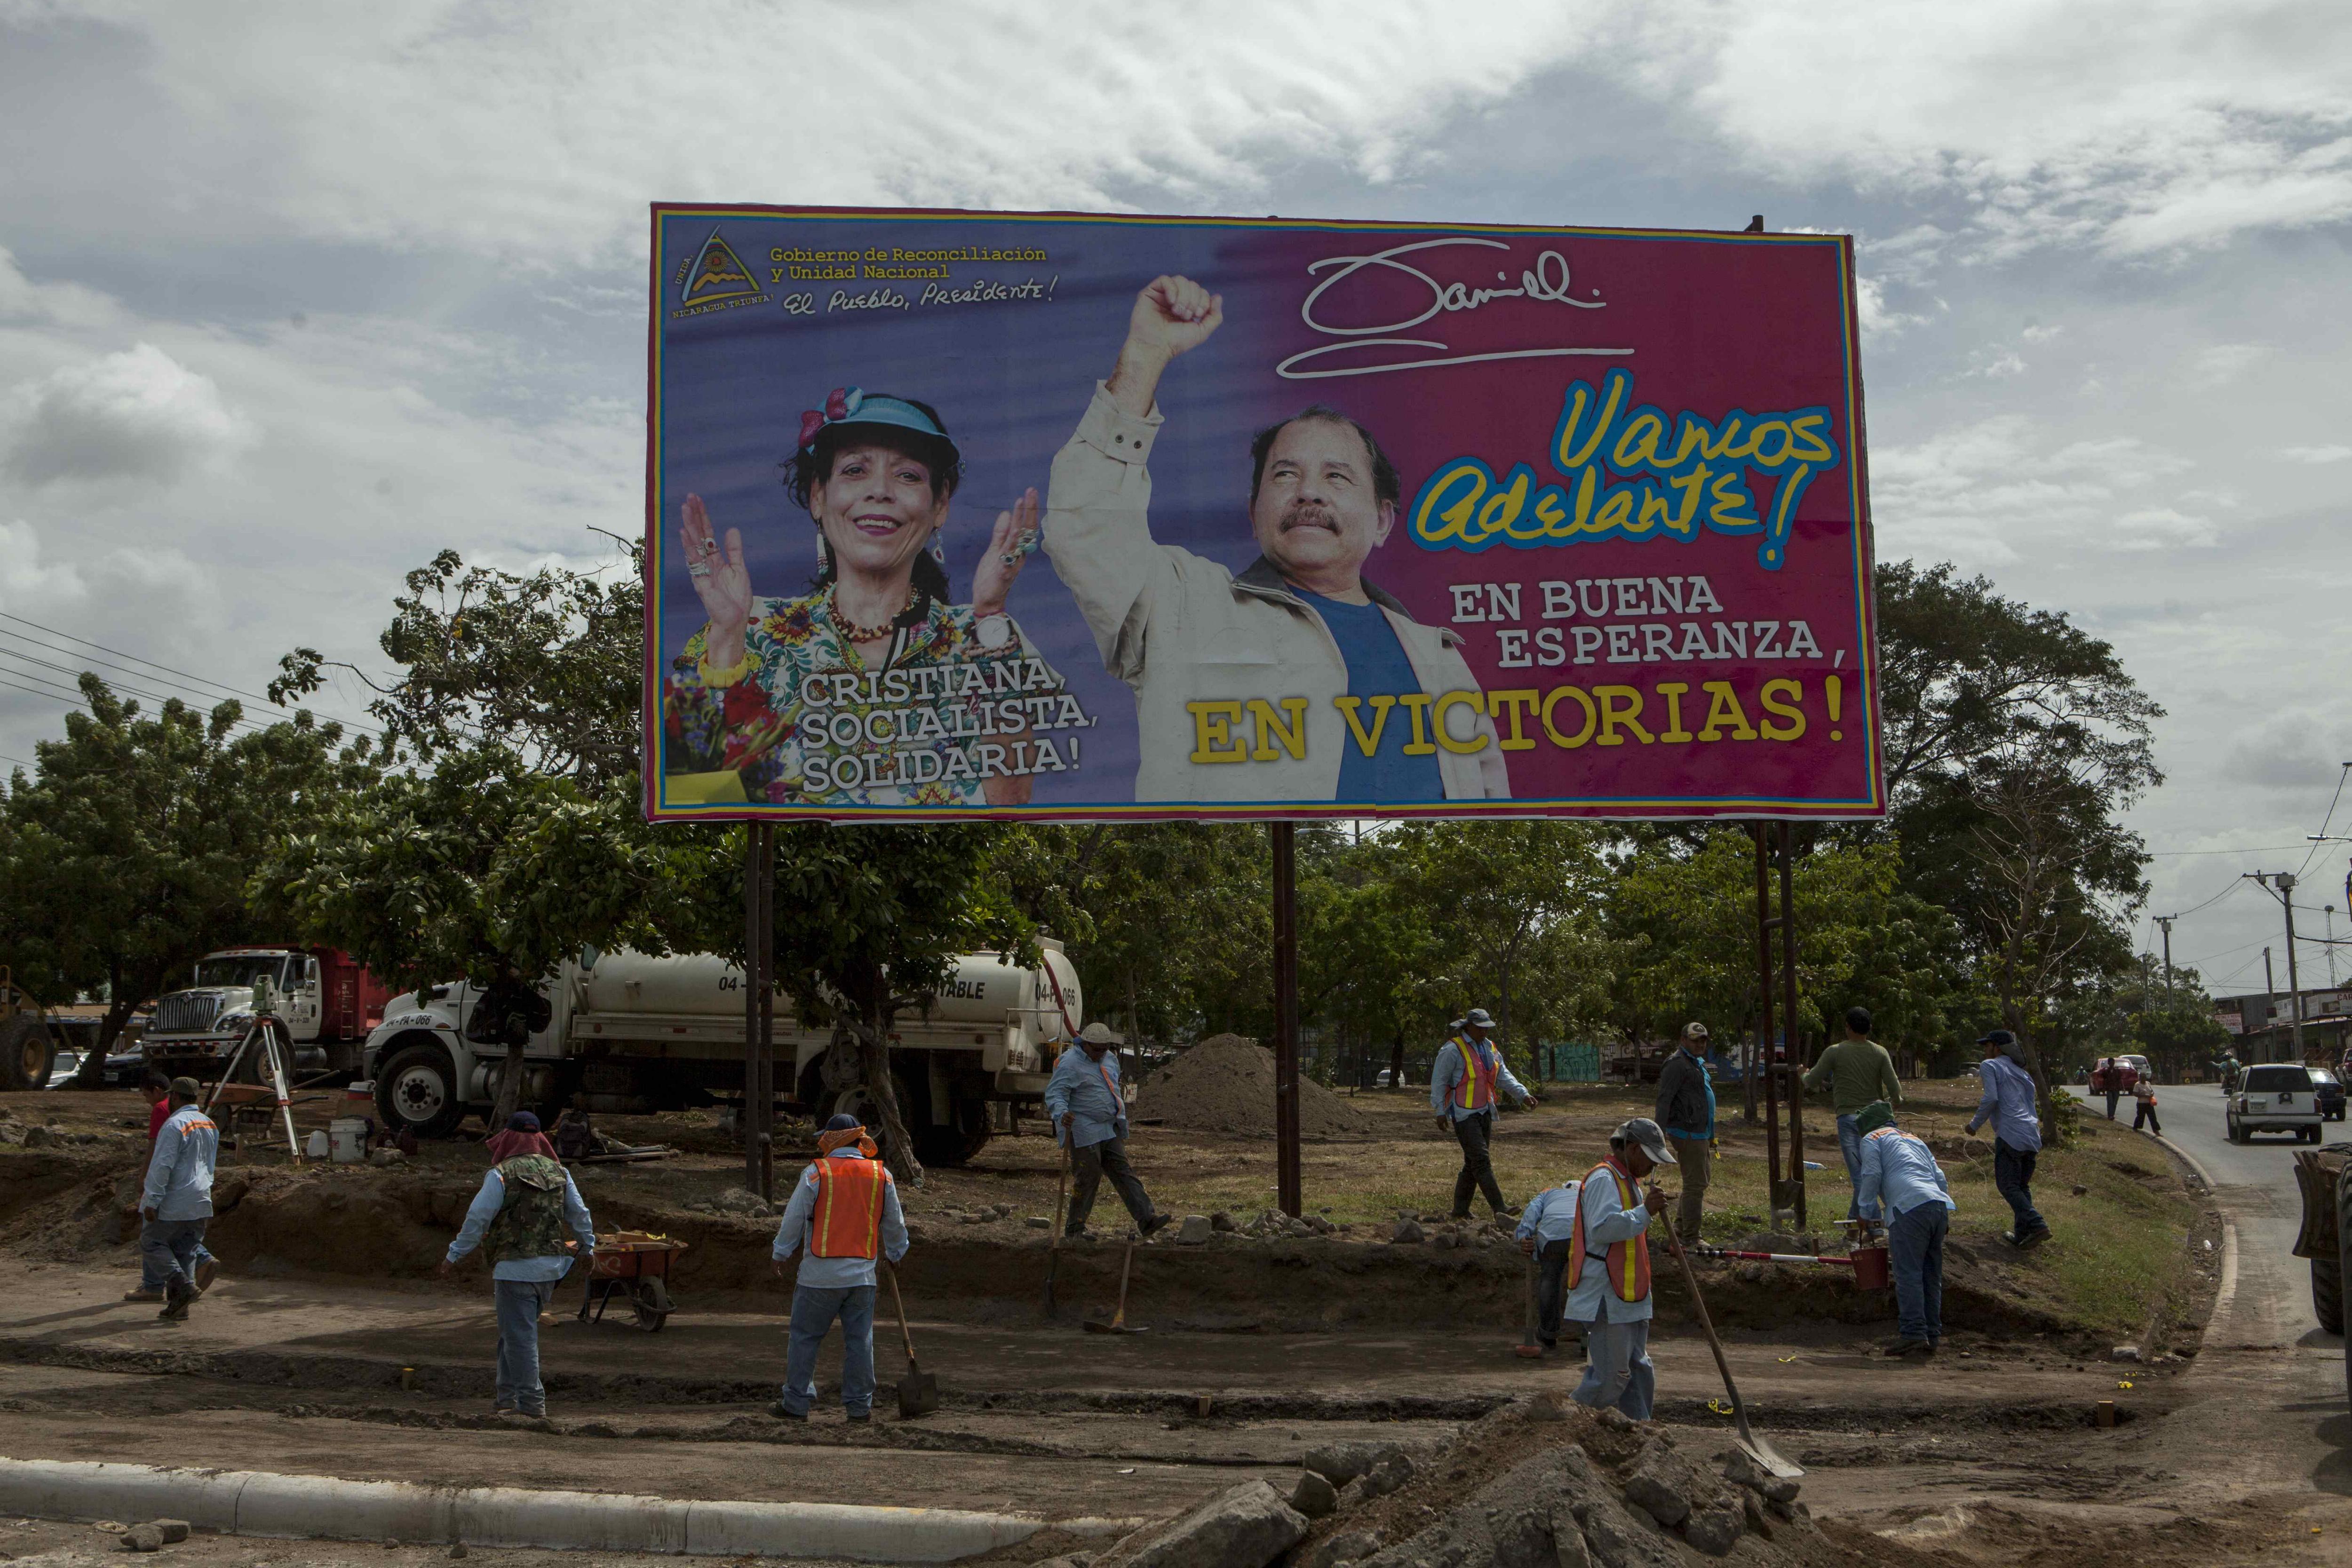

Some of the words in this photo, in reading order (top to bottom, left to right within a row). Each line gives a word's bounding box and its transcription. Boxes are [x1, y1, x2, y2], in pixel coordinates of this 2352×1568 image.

[770, 247, 860, 262] Gobierno
[864, 248, 888, 262] de
[892, 247, 1047, 262] Reconciliación
[771, 268, 783, 282] y
[789, 264, 857, 279] Unidad
[864, 264, 950, 279] Nacional
[672, 302, 726, 319] NICARAGUA
[1449, 581, 1523, 624] EN
[1541, 575, 1724, 620] BUENA
[1495, 620, 1847, 669] ESPERANZA,
[801, 658, 1066, 708] CRISTIANA,
[801, 694, 1099, 750] SOCIALISTA,
[1185, 697, 1309, 764] EN
[1333, 675, 1844, 758] VICTORIAS!
[803, 736, 1080, 793] SOLIDARIA!
